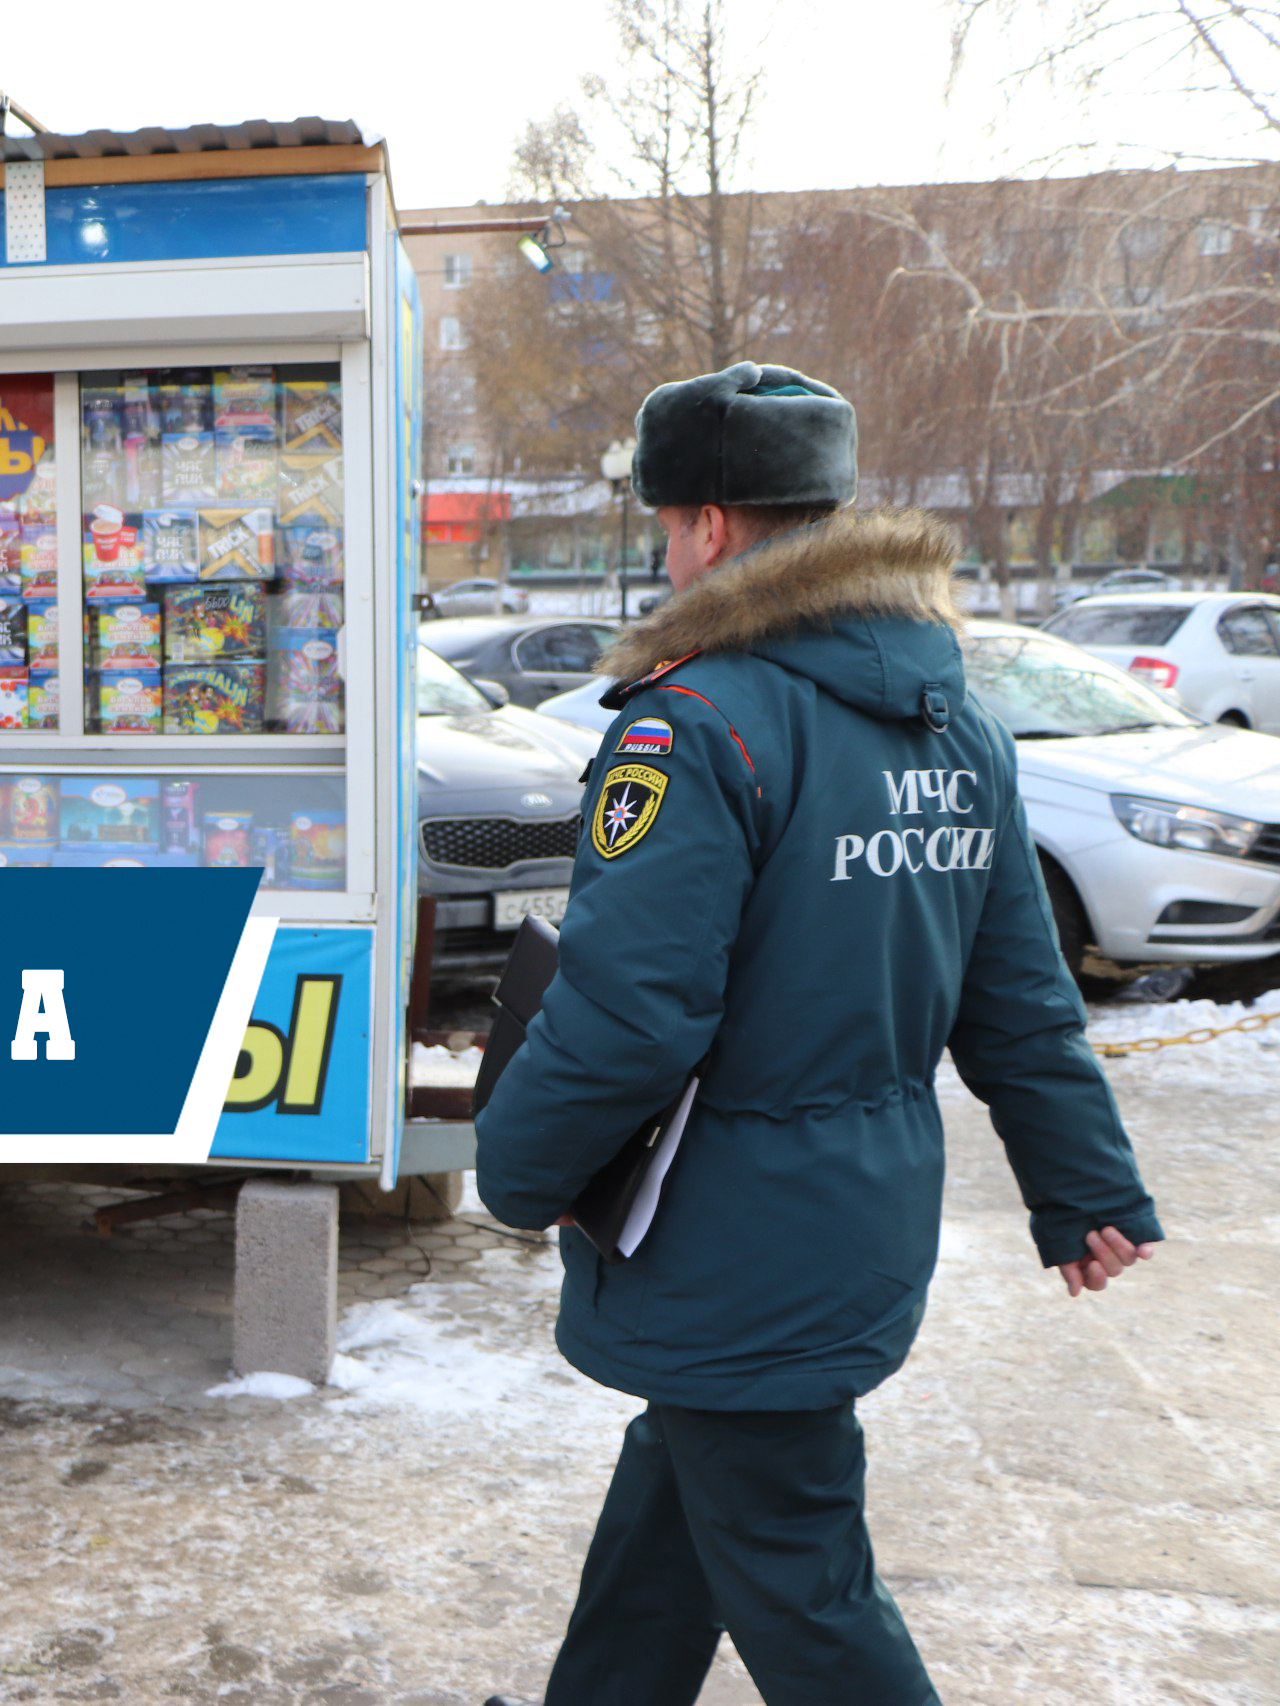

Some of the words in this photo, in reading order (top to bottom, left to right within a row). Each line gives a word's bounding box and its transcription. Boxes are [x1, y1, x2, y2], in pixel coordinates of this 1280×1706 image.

[295, 402, 336, 431] TRICK
[176, 460, 203, 473] ЧАС
[288, 475, 330, 504] TRICK
[208, 527, 249, 558] TRICK
[625, 743, 661, 752] RUSSIA
[625, 768, 663, 787] РОССИИ
[882, 769, 977, 815] МЧС
[830, 826, 995, 881] РОССИИ
